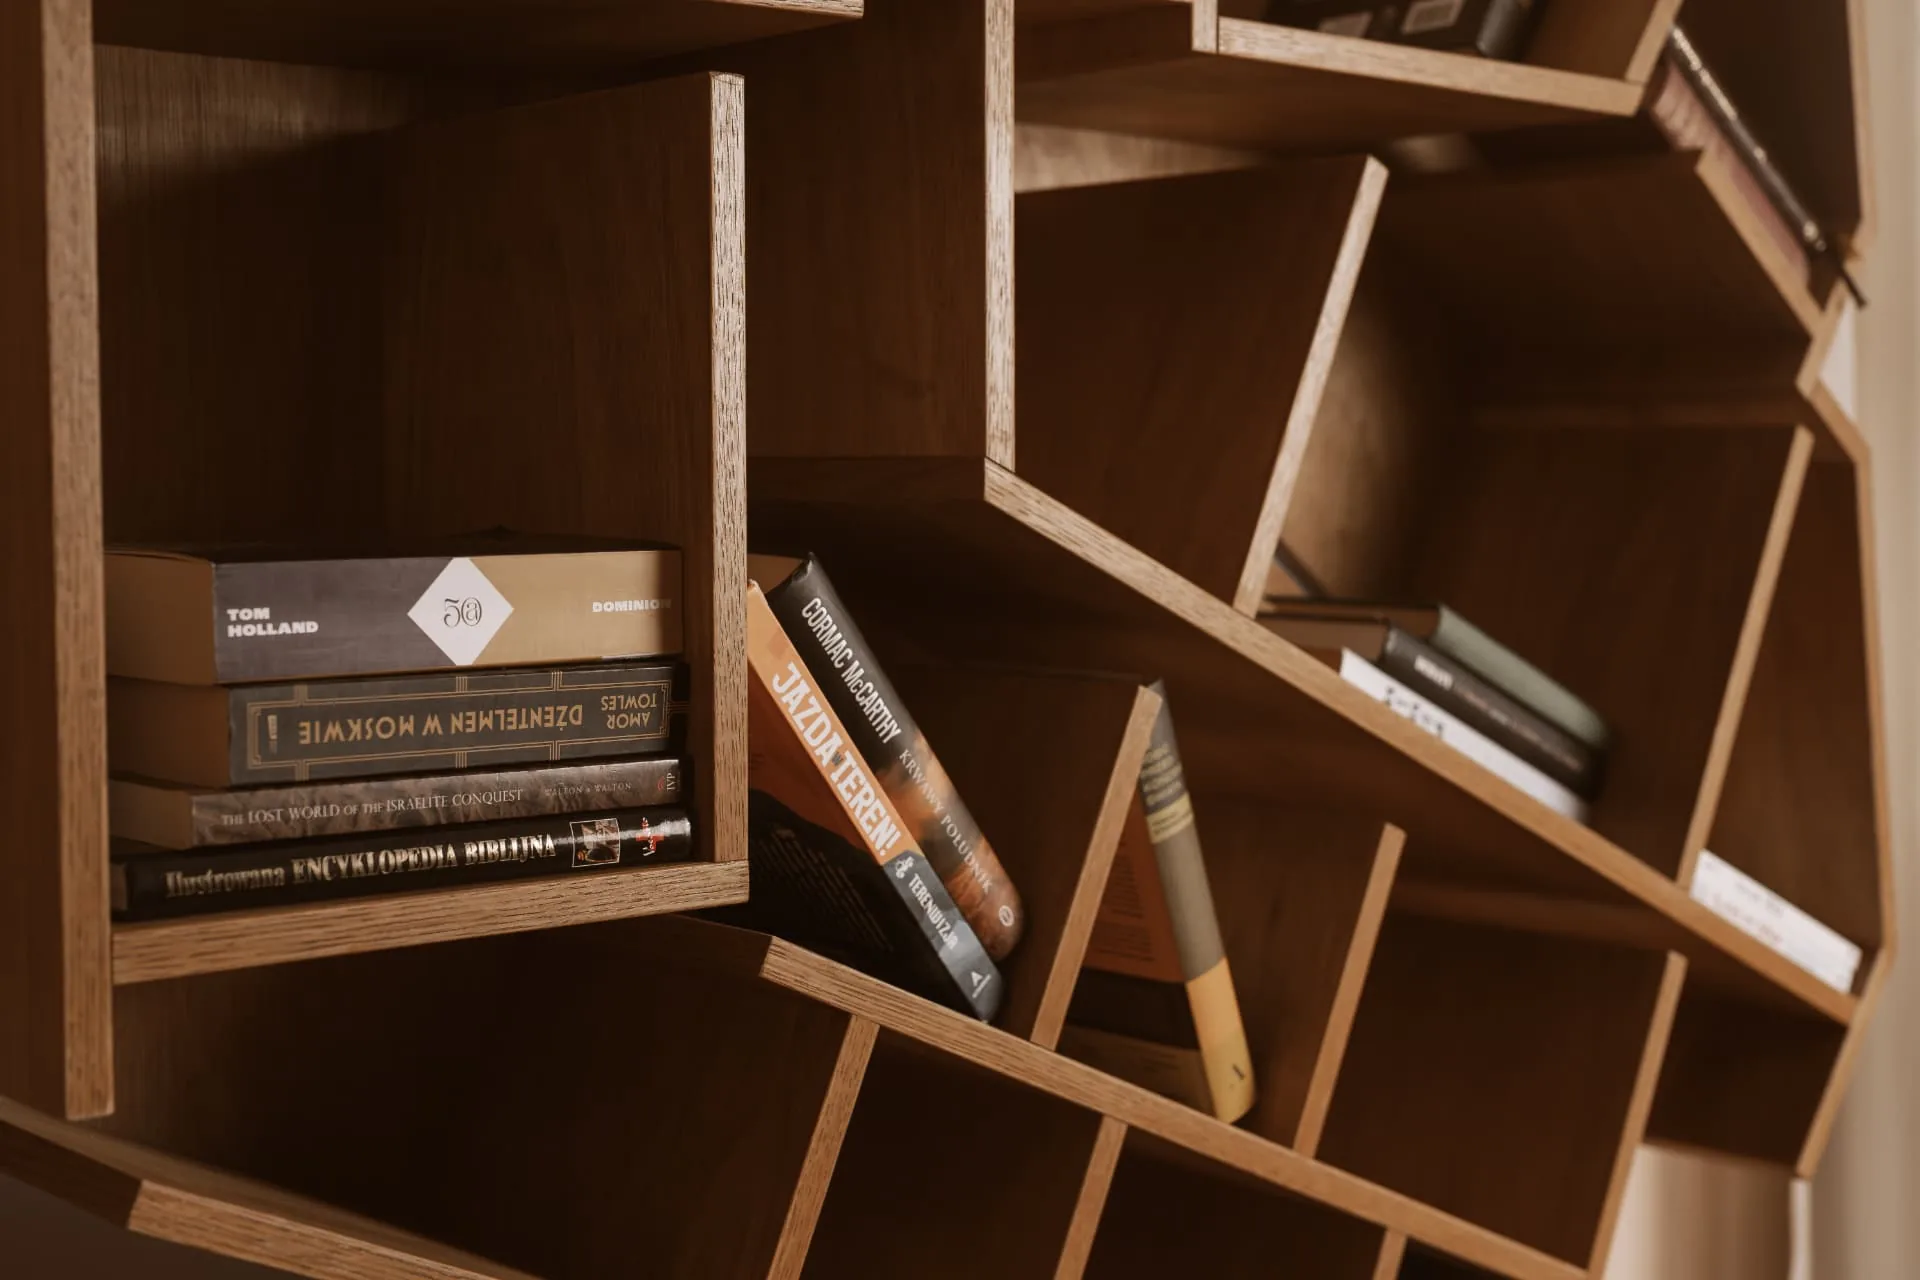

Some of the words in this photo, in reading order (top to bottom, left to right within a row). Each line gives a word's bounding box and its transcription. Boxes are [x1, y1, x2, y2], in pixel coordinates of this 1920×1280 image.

[226, 607, 270, 621] TOM
[592, 599, 672, 613] DOMINION
[227, 621, 319, 637] HOLLAND
[801, 597, 854, 669] CORMAC
[841, 659, 902, 744] McCARTHY
[601, 692, 657, 711] TOWLES
[299, 714, 415, 745] MOSKWIE
[422, 713, 443, 736] W
[451, 704, 583, 735] DŻENTELMEN
[606, 711, 651, 729] AMOR
[772, 661, 843, 768] JAZDA
[830, 751, 901, 856] TEREN!
[544, 785, 584, 798] WALTON
[594, 782, 632, 794] WALTON
[666, 773, 678, 792] IVP
[221, 813, 244, 827] THE
[248, 808, 284, 824] LOST
[288, 803, 340, 822] WORLD
[343, 803, 359, 816] OF
[362, 802, 384, 815] THE
[386, 795, 449, 812] ISRAELITE
[452, 788, 524, 808] CONQUEST
[899, 749, 945, 814] KRWAWY
[940, 814, 993, 894] POŁUDNIK
[165, 867, 285, 897] Ilustrowana
[291, 844, 458, 883] ENCYKLOPEDIA
[464, 834, 556, 864] BIBLIJNA
[908, 872, 958, 950] TERENWIZJA
